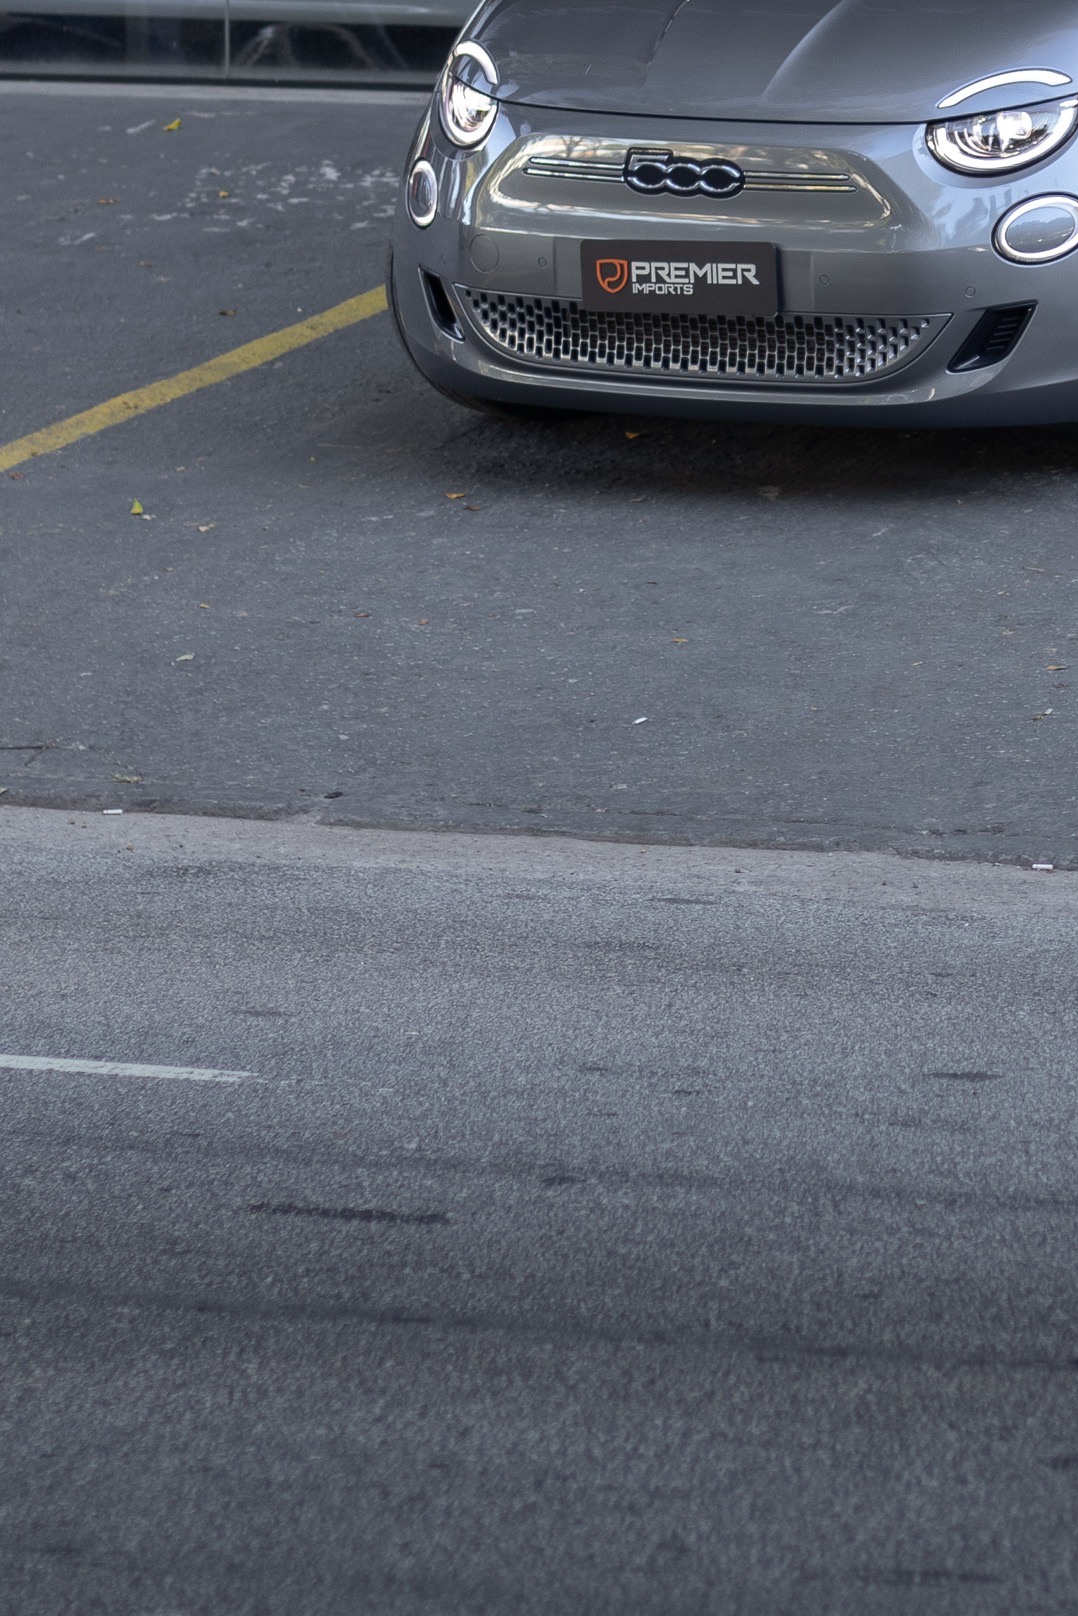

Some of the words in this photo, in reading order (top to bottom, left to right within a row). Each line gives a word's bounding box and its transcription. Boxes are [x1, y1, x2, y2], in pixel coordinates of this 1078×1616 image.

[623, 147, 746, 200] 500
[631, 261, 760, 285] PREMIER
[632, 284, 694, 295] IMPORTS
